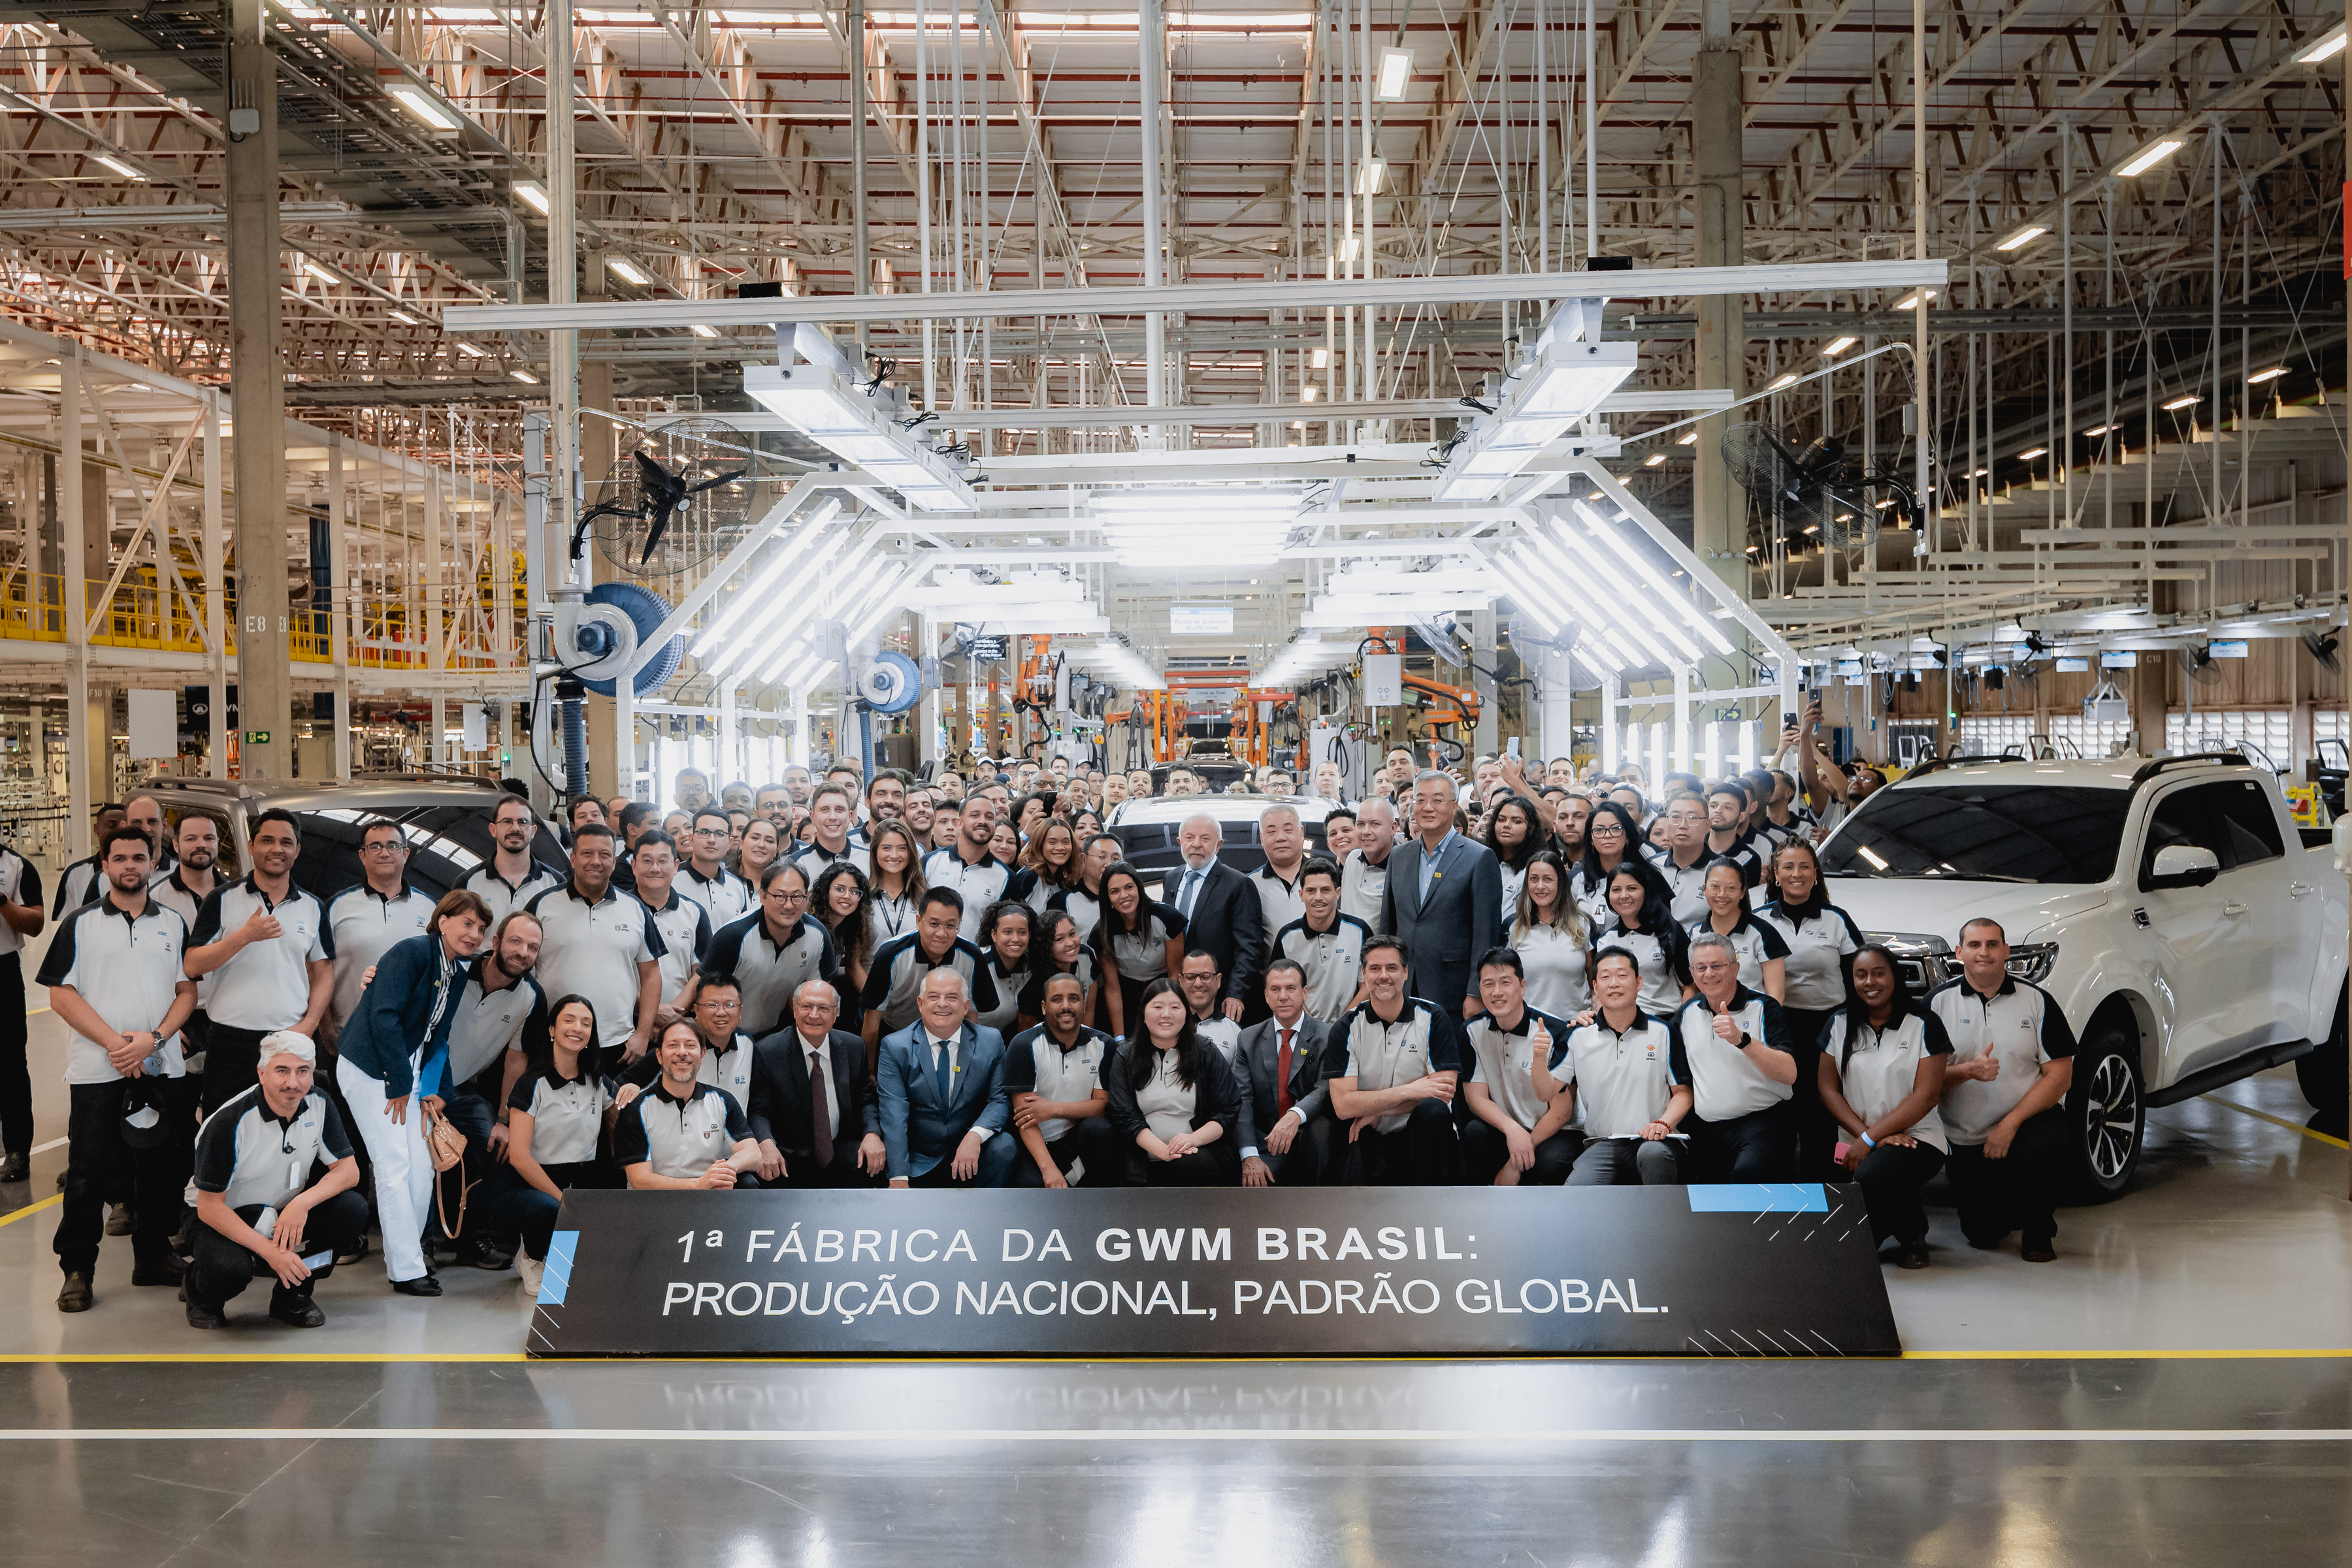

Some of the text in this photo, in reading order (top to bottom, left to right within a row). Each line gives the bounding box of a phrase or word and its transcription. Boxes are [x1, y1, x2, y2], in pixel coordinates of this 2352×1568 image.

[246, 615, 267, 632] E8
[279, 615, 287, 632] E8
[2146, 655, 2161, 663] C10
[88, 689, 102, 697] F10
[678, 1222, 1478, 1263] 1ª FÁBRICA DA GWM BRASIL:
[662, 1271, 1669, 1325] PRODUÇÃO NACIONAL, PADRÃO GLOBAL.
